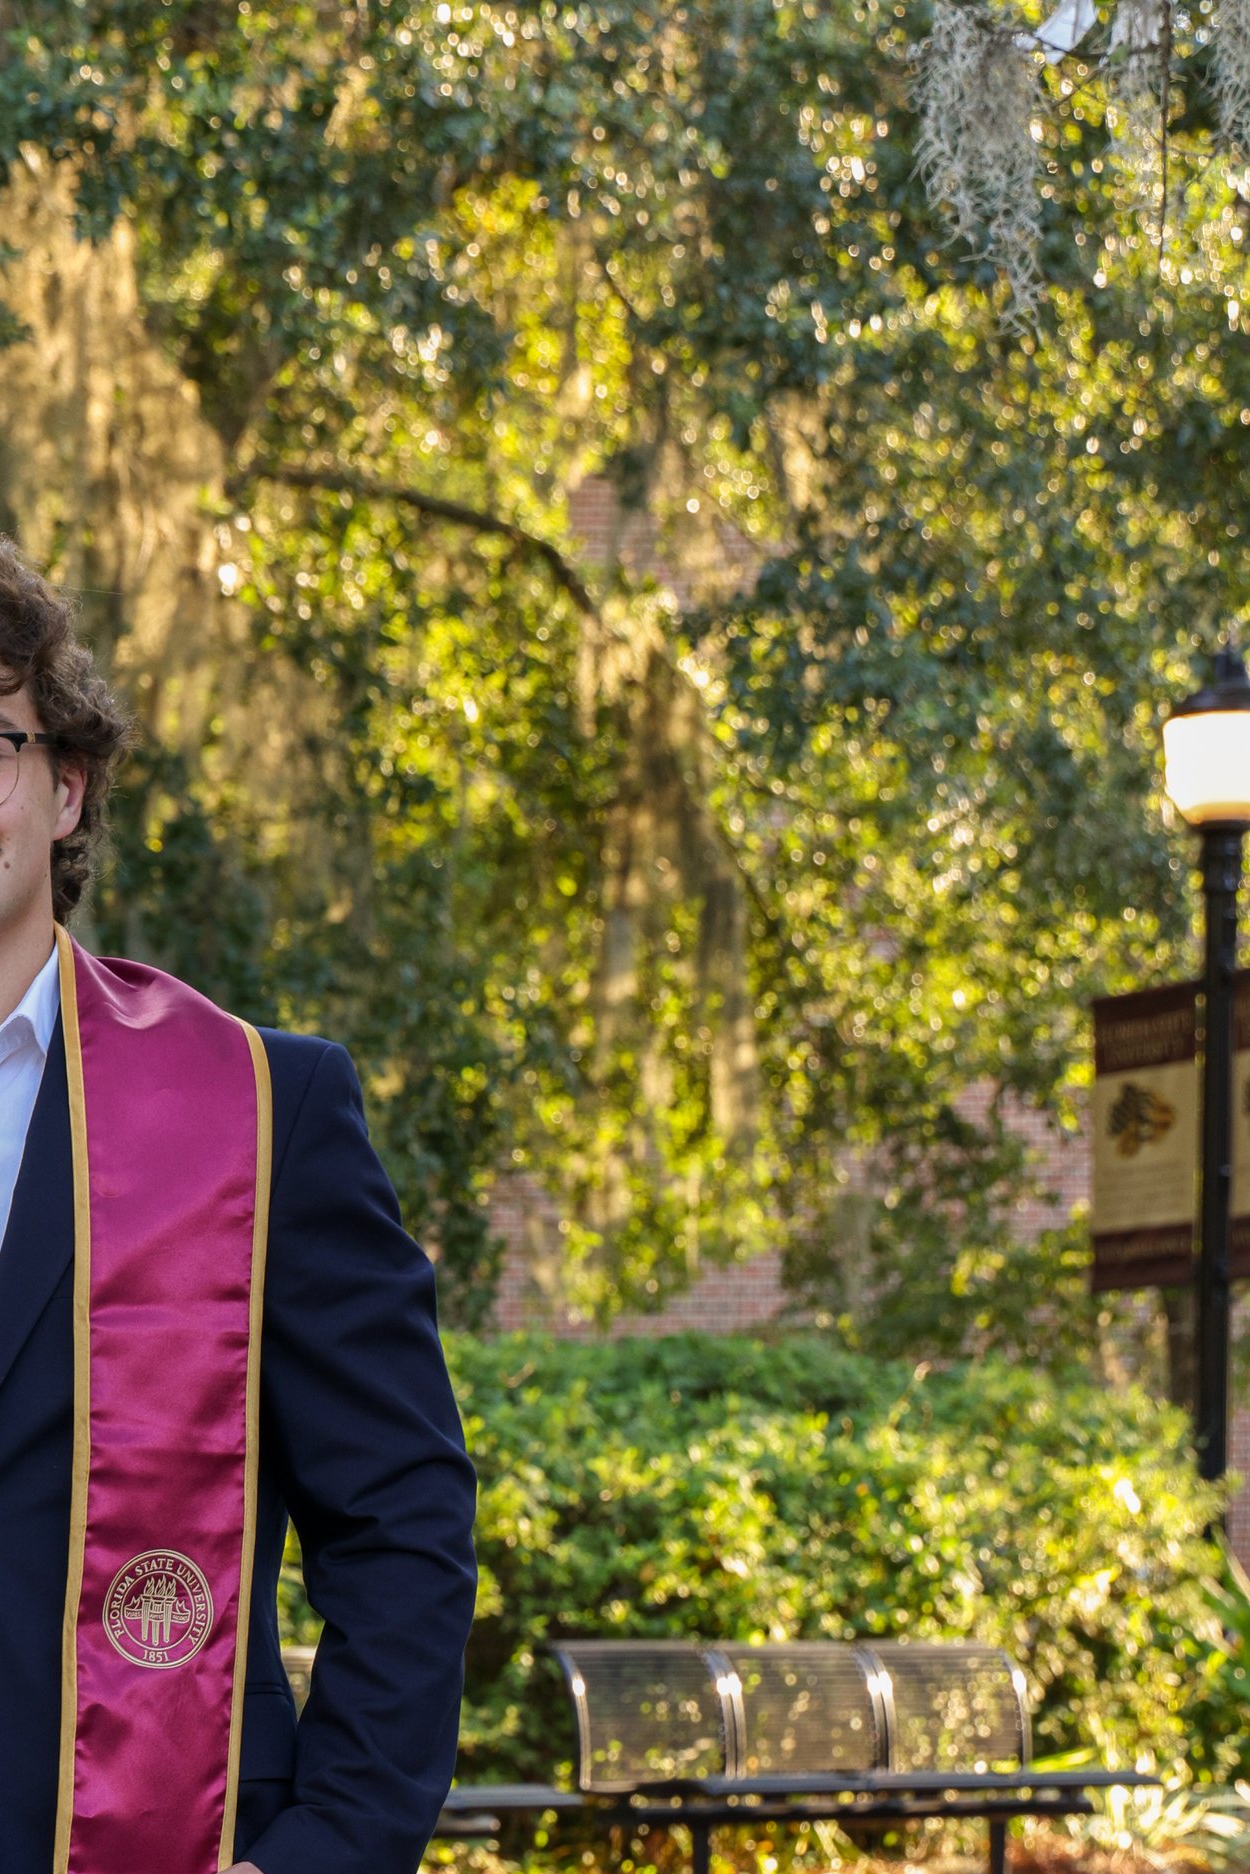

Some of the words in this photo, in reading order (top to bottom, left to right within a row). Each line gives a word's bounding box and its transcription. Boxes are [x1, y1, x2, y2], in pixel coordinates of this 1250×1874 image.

[110, 1575, 134, 1639] FLORIDA
[134, 1558, 174, 1576] STATE
[176, 1564, 206, 1645] UNIVERSITY
[142, 1649, 169, 1662] 1851
